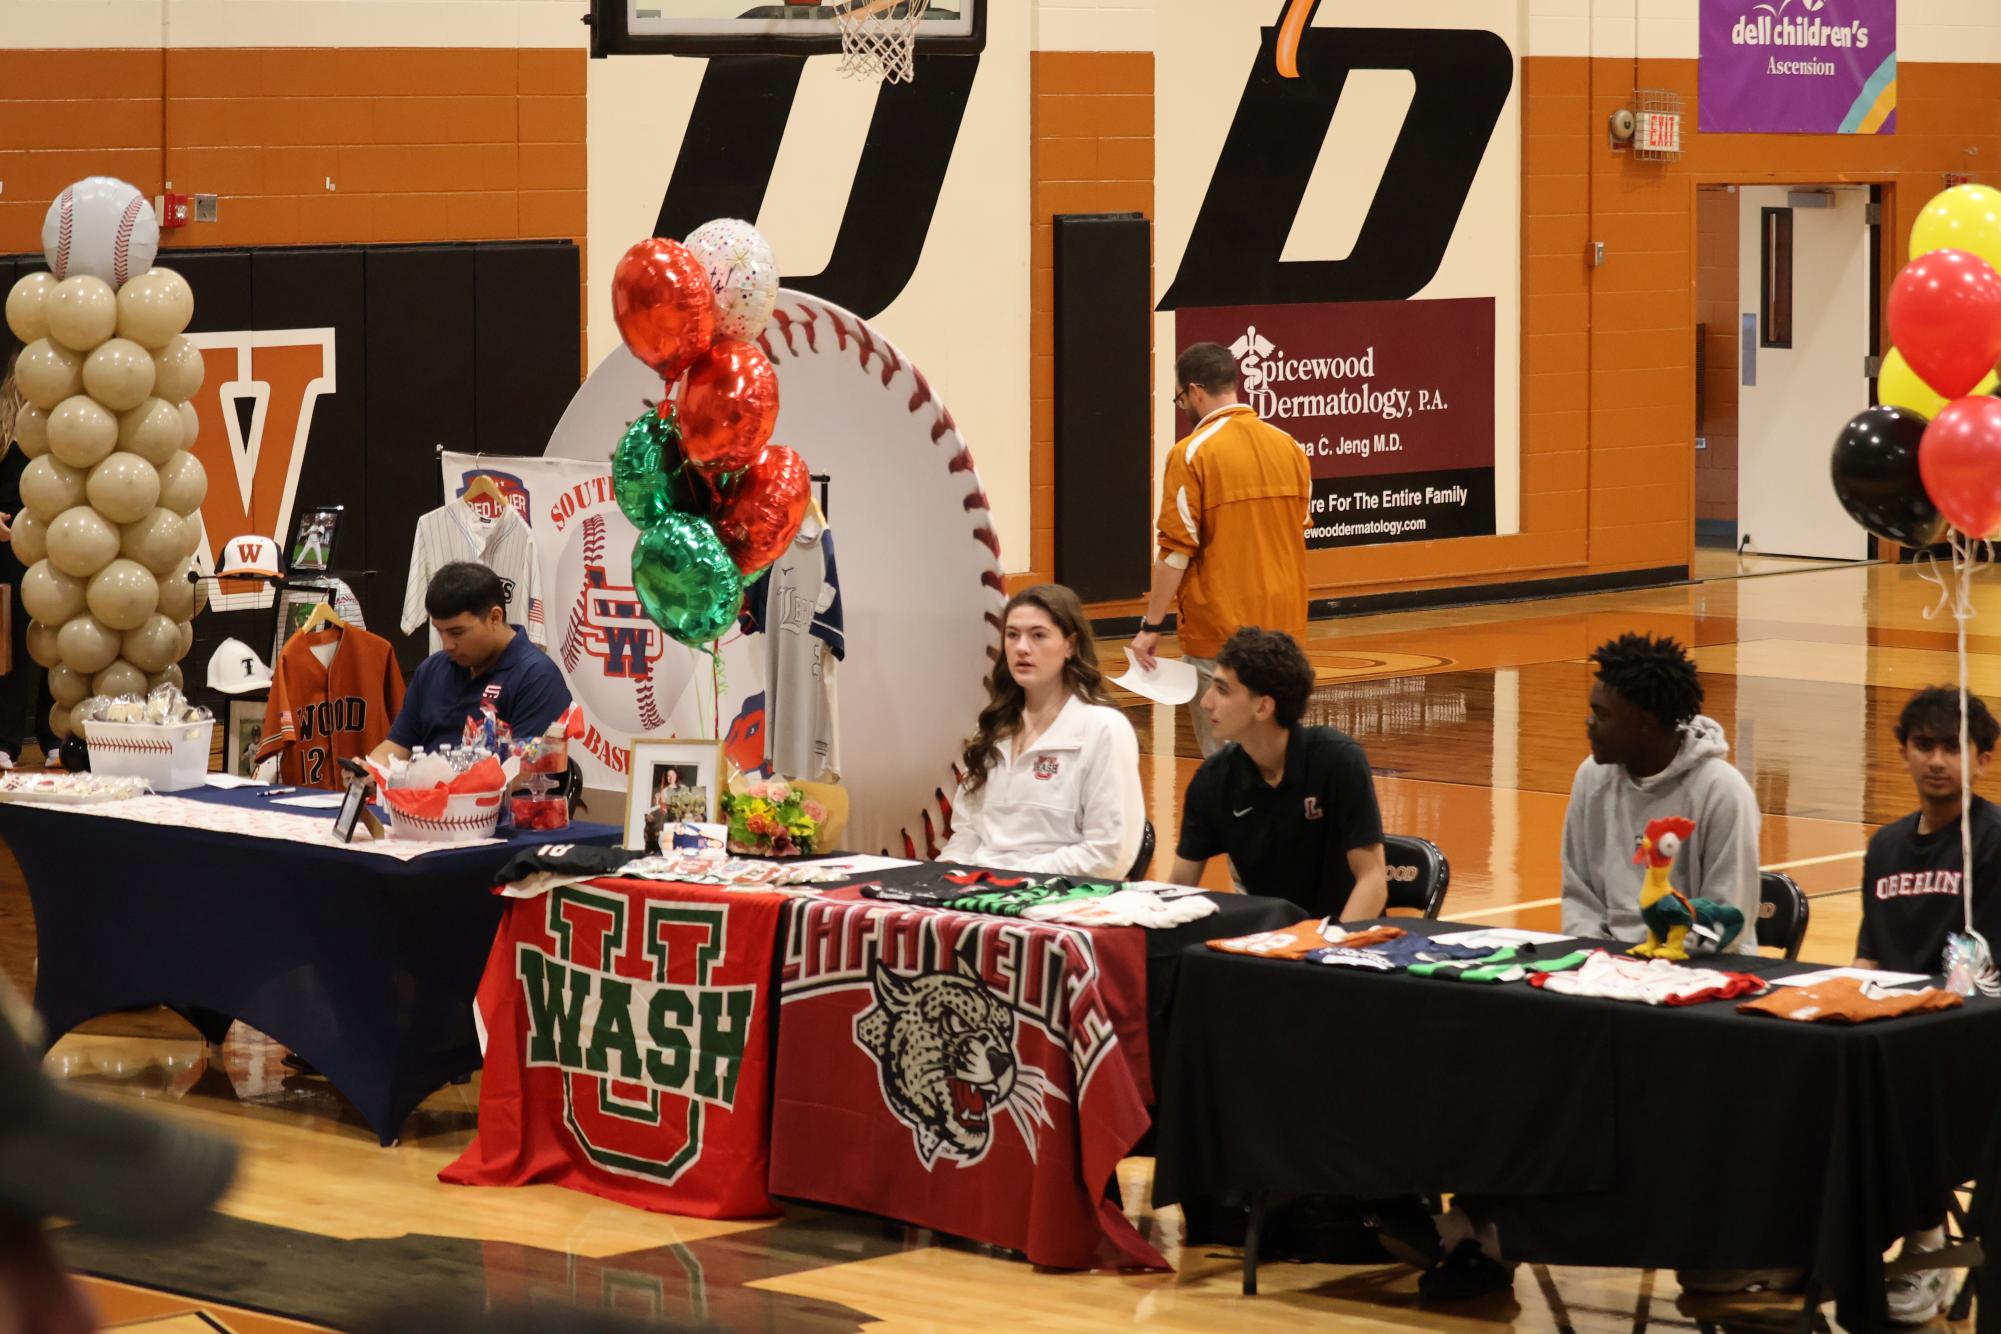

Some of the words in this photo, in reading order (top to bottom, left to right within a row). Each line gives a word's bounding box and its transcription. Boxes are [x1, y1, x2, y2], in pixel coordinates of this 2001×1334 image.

[1732, 16, 1771, 46] dell
[1773, 16, 1869, 49] children's
[1767, 55, 1836, 76] Ascension
[1649, 114, 1675, 147] EXIT
[1241, 346, 1375, 389] Spicewood
[1258, 383, 1412, 420] Dermatology,
[1418, 388, 1448, 411] P.A.
[1318, 437, 1333, 456] C.
[1336, 436, 1370, 458] Jeng
[1373, 433, 1403, 452] M.D.
[550, 475, 616, 532] SOUT
[1310, 498, 1325, 513] re
[1329, 494, 1352, 512] For
[1353, 492, 1379, 510] The
[1382, 488, 1422, 508] Entire
[1425, 485, 1468, 507] Family
[1304, 517, 1426, 539] ewooddermatology.com
[237, 543, 263, 563] W
[241, 658, 256, 678] T
[1304, 796, 1323, 820] L
[1385, 865, 1419, 882] OOD
[1876, 870, 1962, 900] OBERLIN
[516, 942, 757, 1113] WASH
